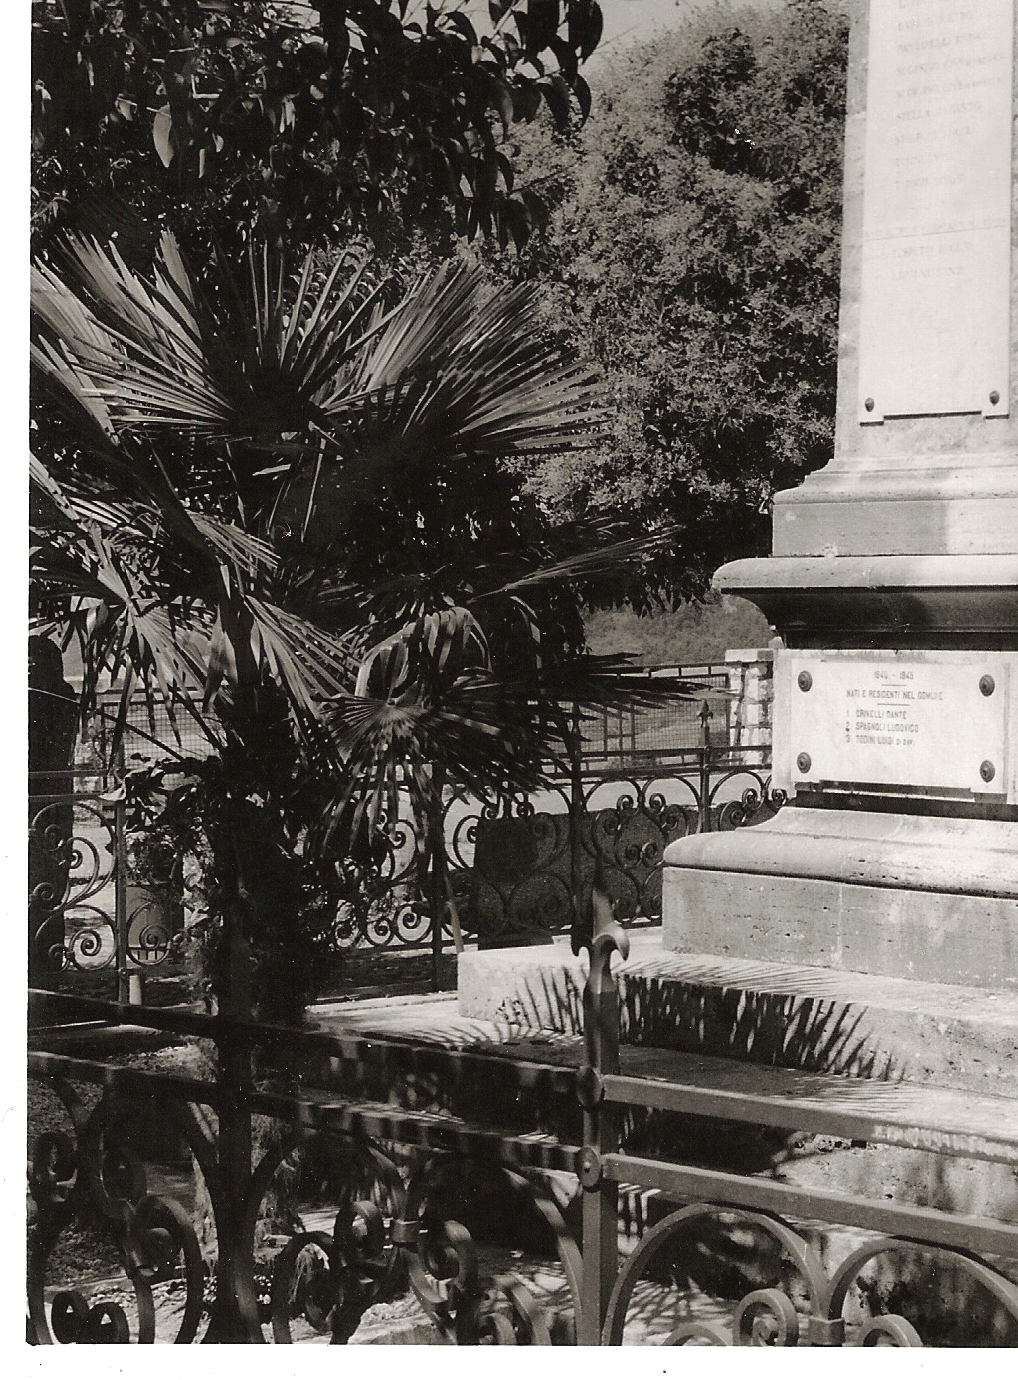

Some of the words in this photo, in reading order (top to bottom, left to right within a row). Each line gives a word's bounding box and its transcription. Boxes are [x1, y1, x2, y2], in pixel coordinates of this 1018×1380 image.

[846, 689, 859, 697] NATI
[868, 690, 899, 698] RESIDENTI
[902, 691, 914, 699] NEL
[855, 721, 885, 731] SPAGNOLI
[887, 723, 918, 732] LUDOVICO
